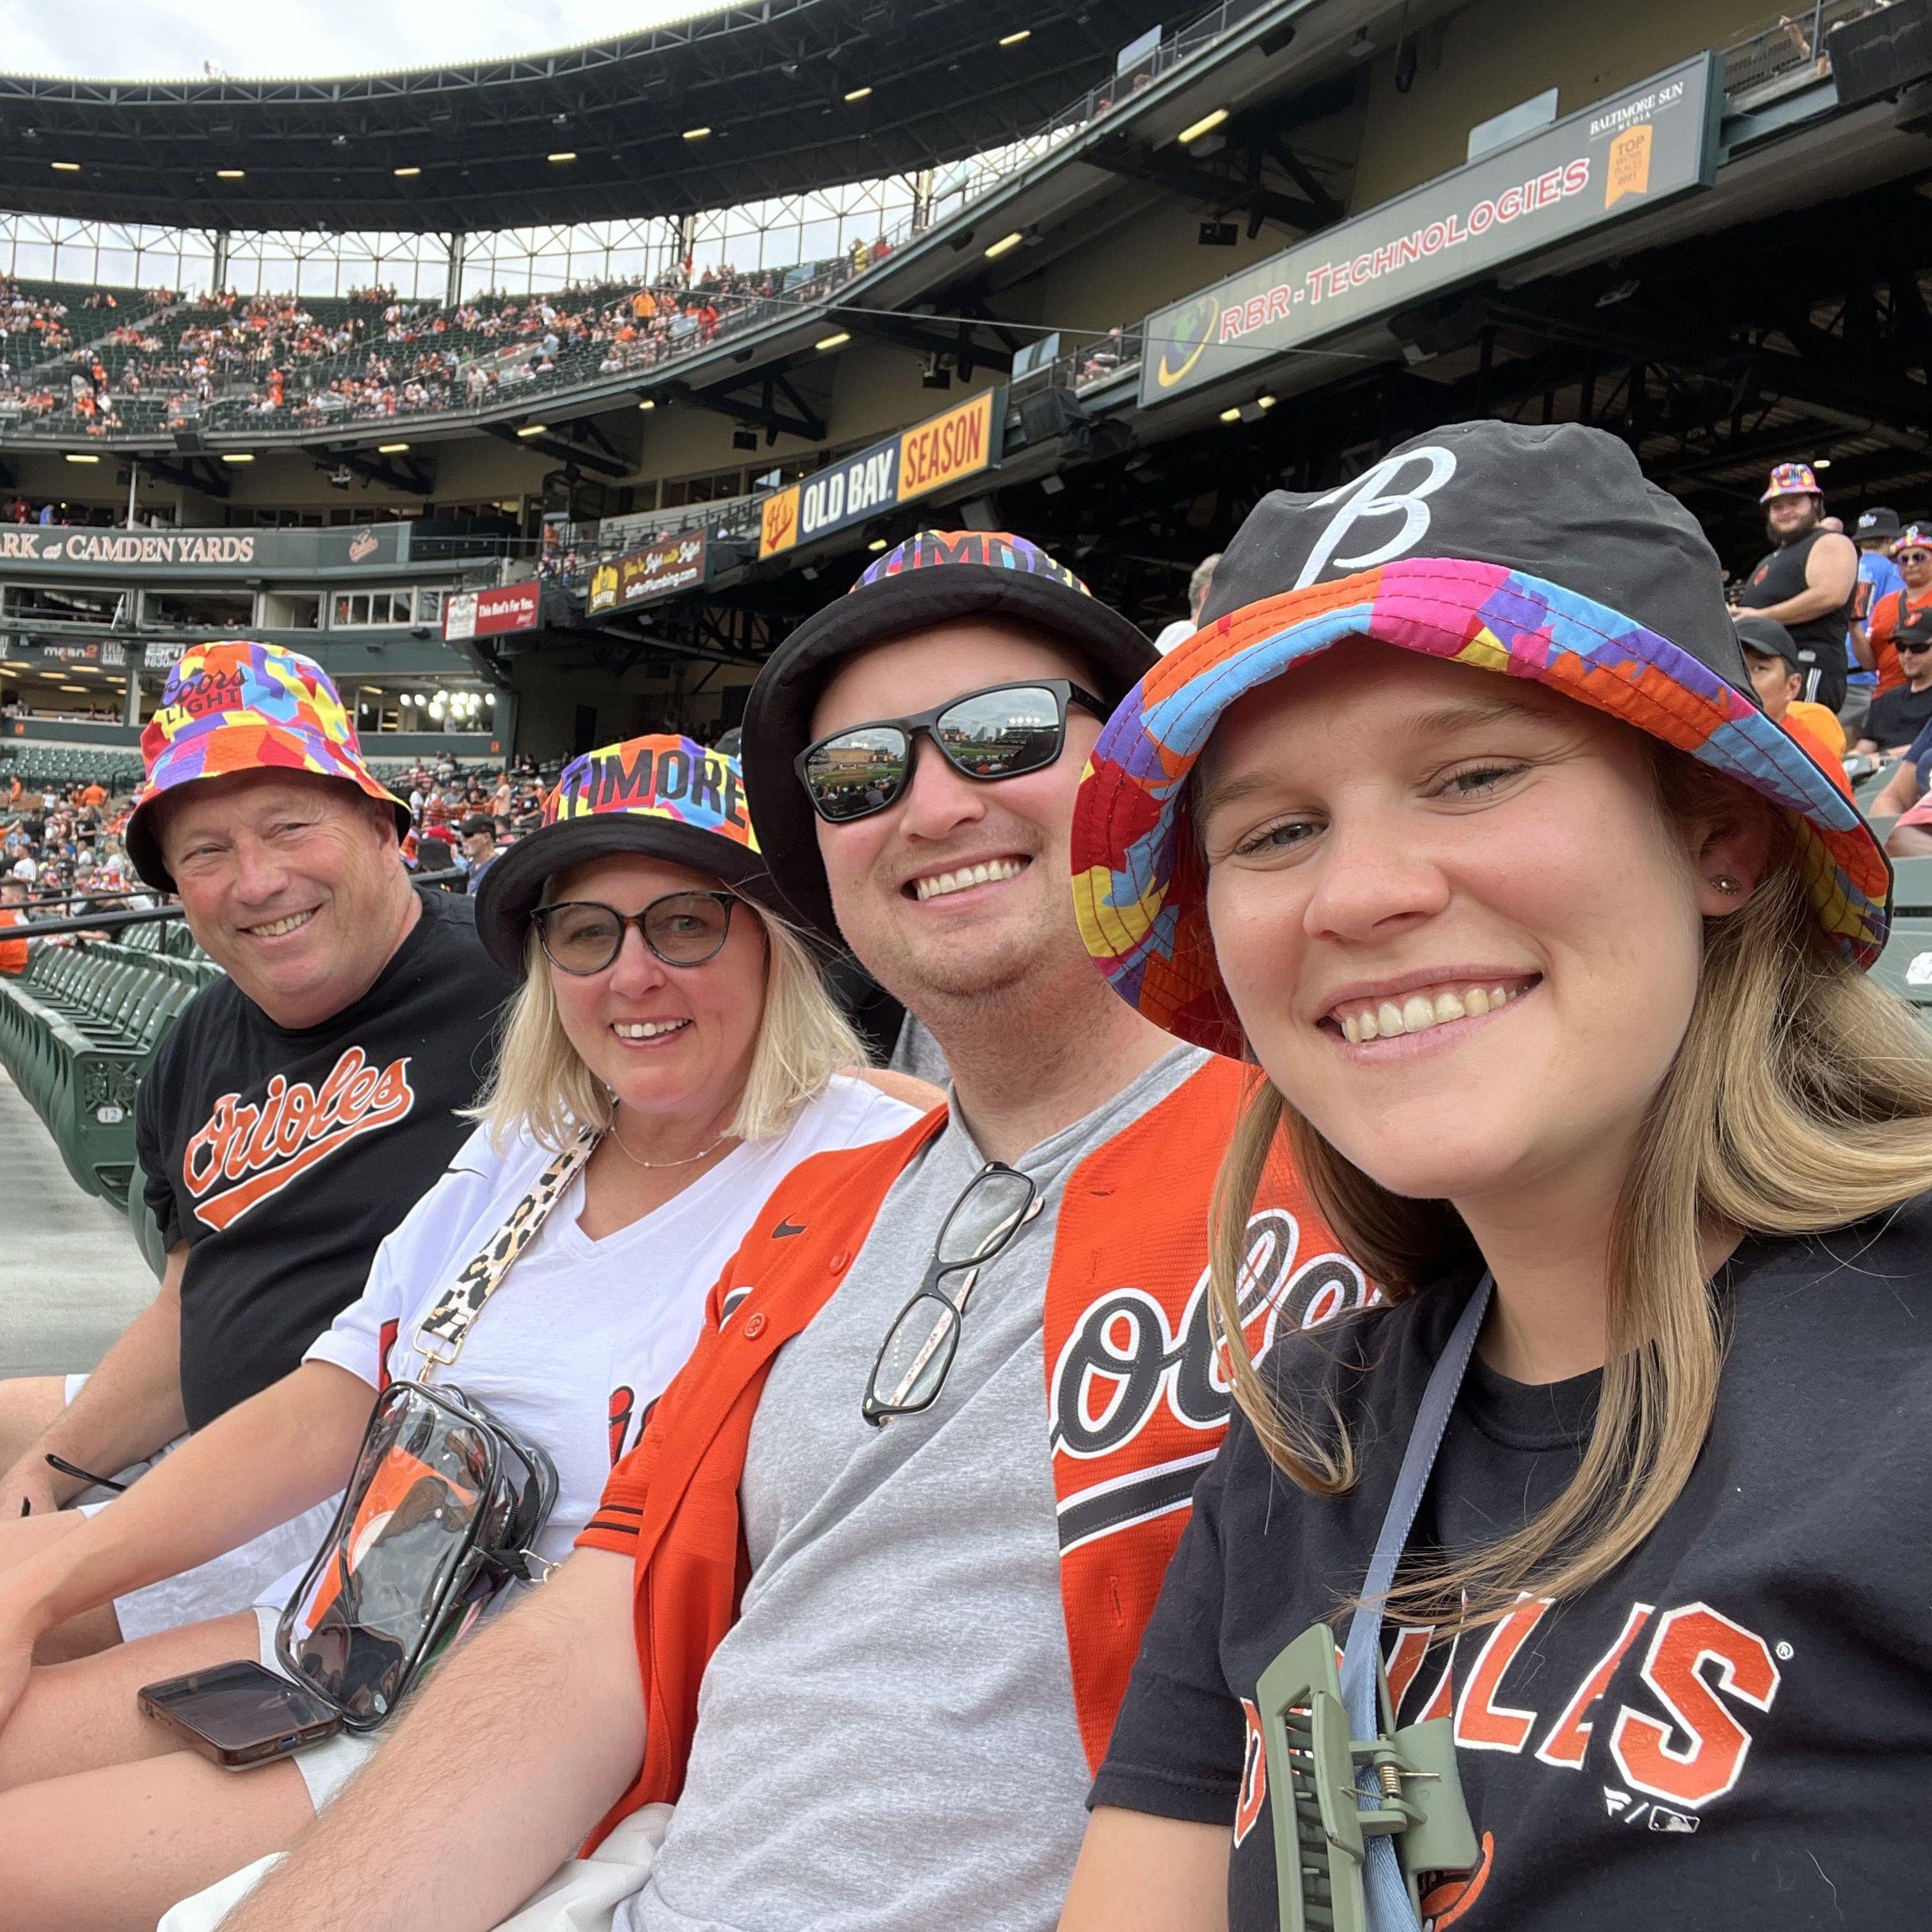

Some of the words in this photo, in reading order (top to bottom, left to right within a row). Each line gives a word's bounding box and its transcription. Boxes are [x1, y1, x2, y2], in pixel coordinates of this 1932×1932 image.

[1590, 94, 1655, 136] BALTIMORE
[1658, 81, 1684, 105] SUN
[1618, 134, 1645, 155] TOP
[802, 473, 845, 533] OLD
[905, 406, 982, 489] SEASON
[1293, 446, 1457, 590] B
[0, 533, 40, 559] RK
[66, 534, 177, 563] CAMDEN
[178, 537, 255, 563] YARDS
[160, 667, 249, 710] Coors
[166, 689, 239, 725] LIGHT
[183, 1045, 415, 1200] Orioles
